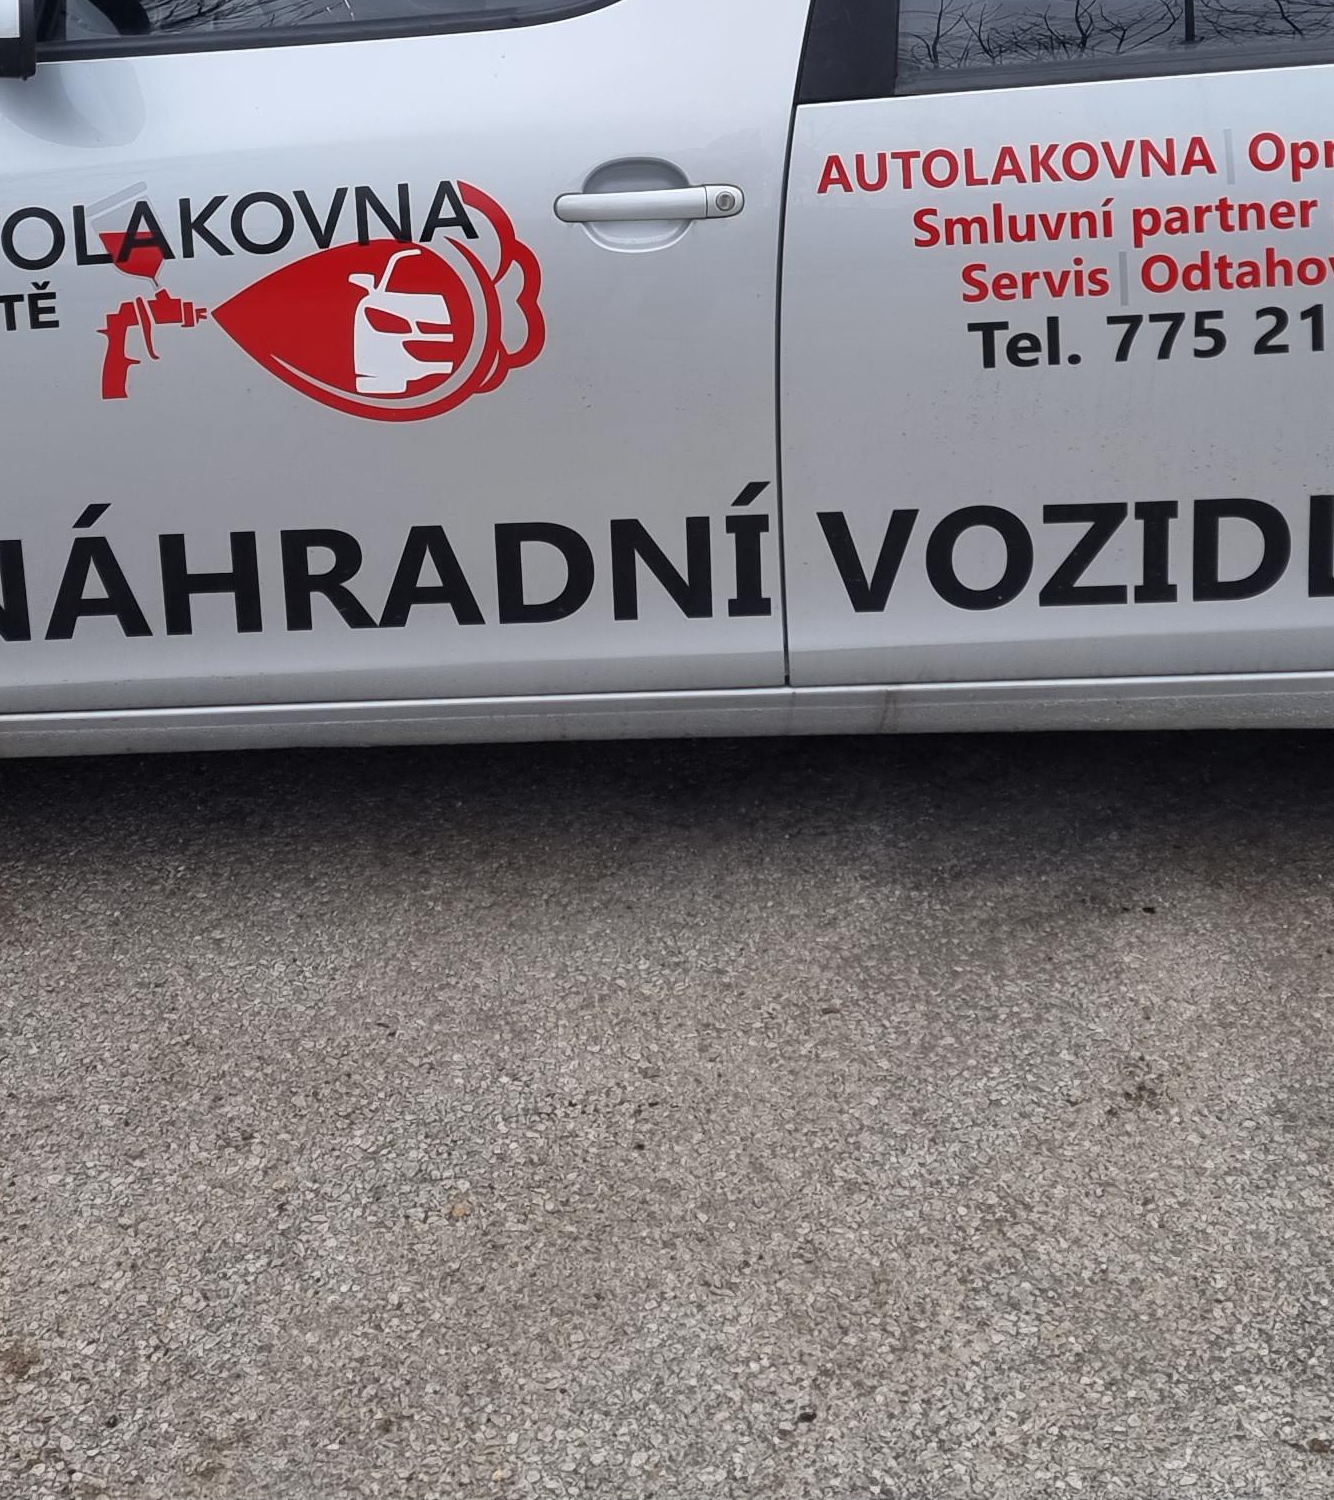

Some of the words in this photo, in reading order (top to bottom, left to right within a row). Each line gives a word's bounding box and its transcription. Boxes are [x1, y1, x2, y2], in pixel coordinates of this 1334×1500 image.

[818, 135, 1217, 194] AUTOLAKOVNA
[913, 198, 1114, 248] Smluvní
[1132, 196, 1318, 249] partner
[961, 257, 1111, 303] Servis
[967, 315, 1082, 369] Tel.
[1106, 310, 1228, 363] 775
